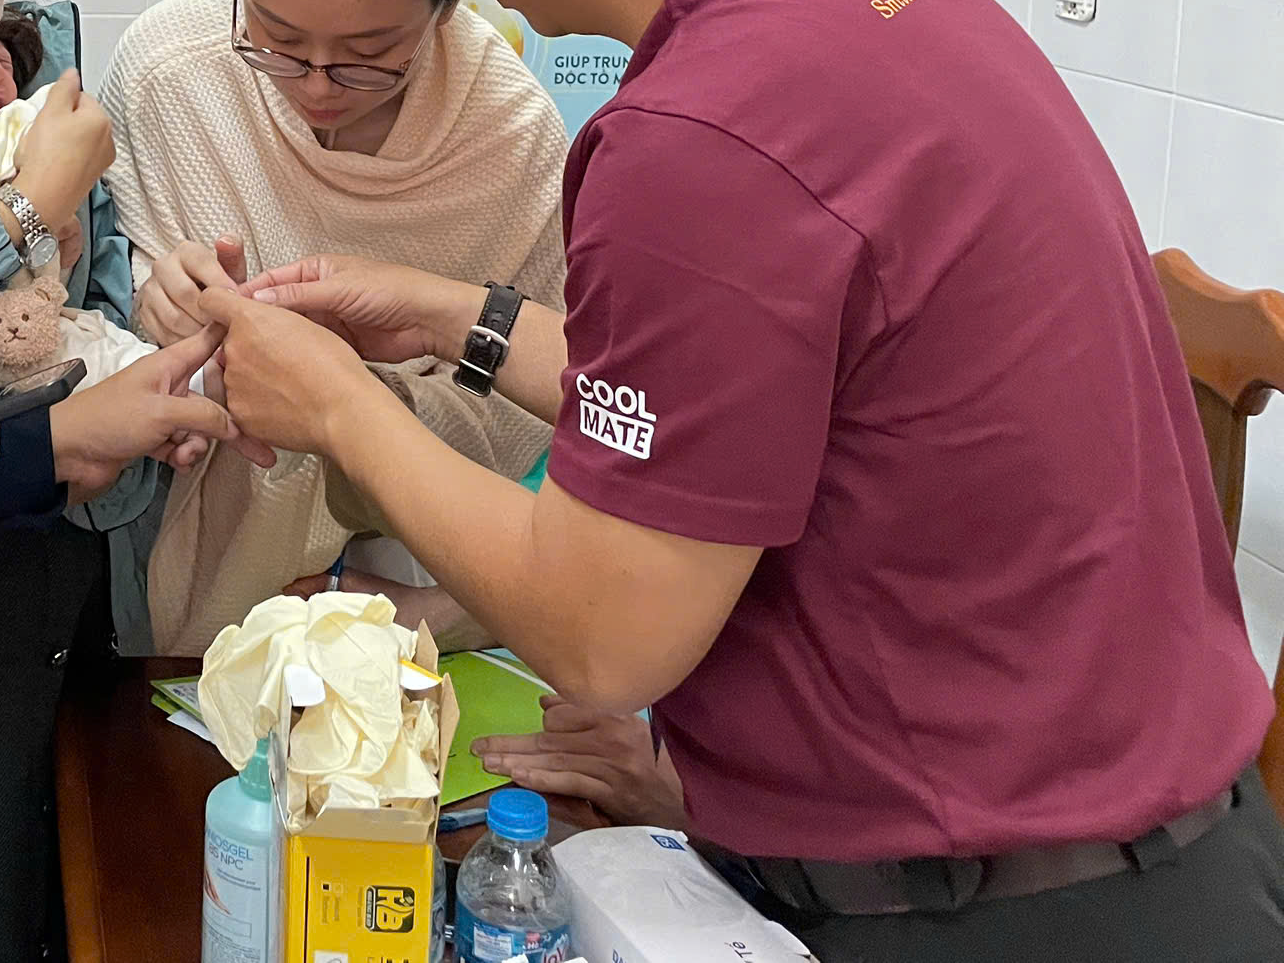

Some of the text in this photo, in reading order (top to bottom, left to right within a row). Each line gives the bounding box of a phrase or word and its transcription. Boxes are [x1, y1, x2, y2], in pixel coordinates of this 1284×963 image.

[554, 53, 590, 69] GIÚP
[576, 372, 657, 423] COOL
[583, 404, 650, 454] MATE
[220, 852, 244, 871] NPC
